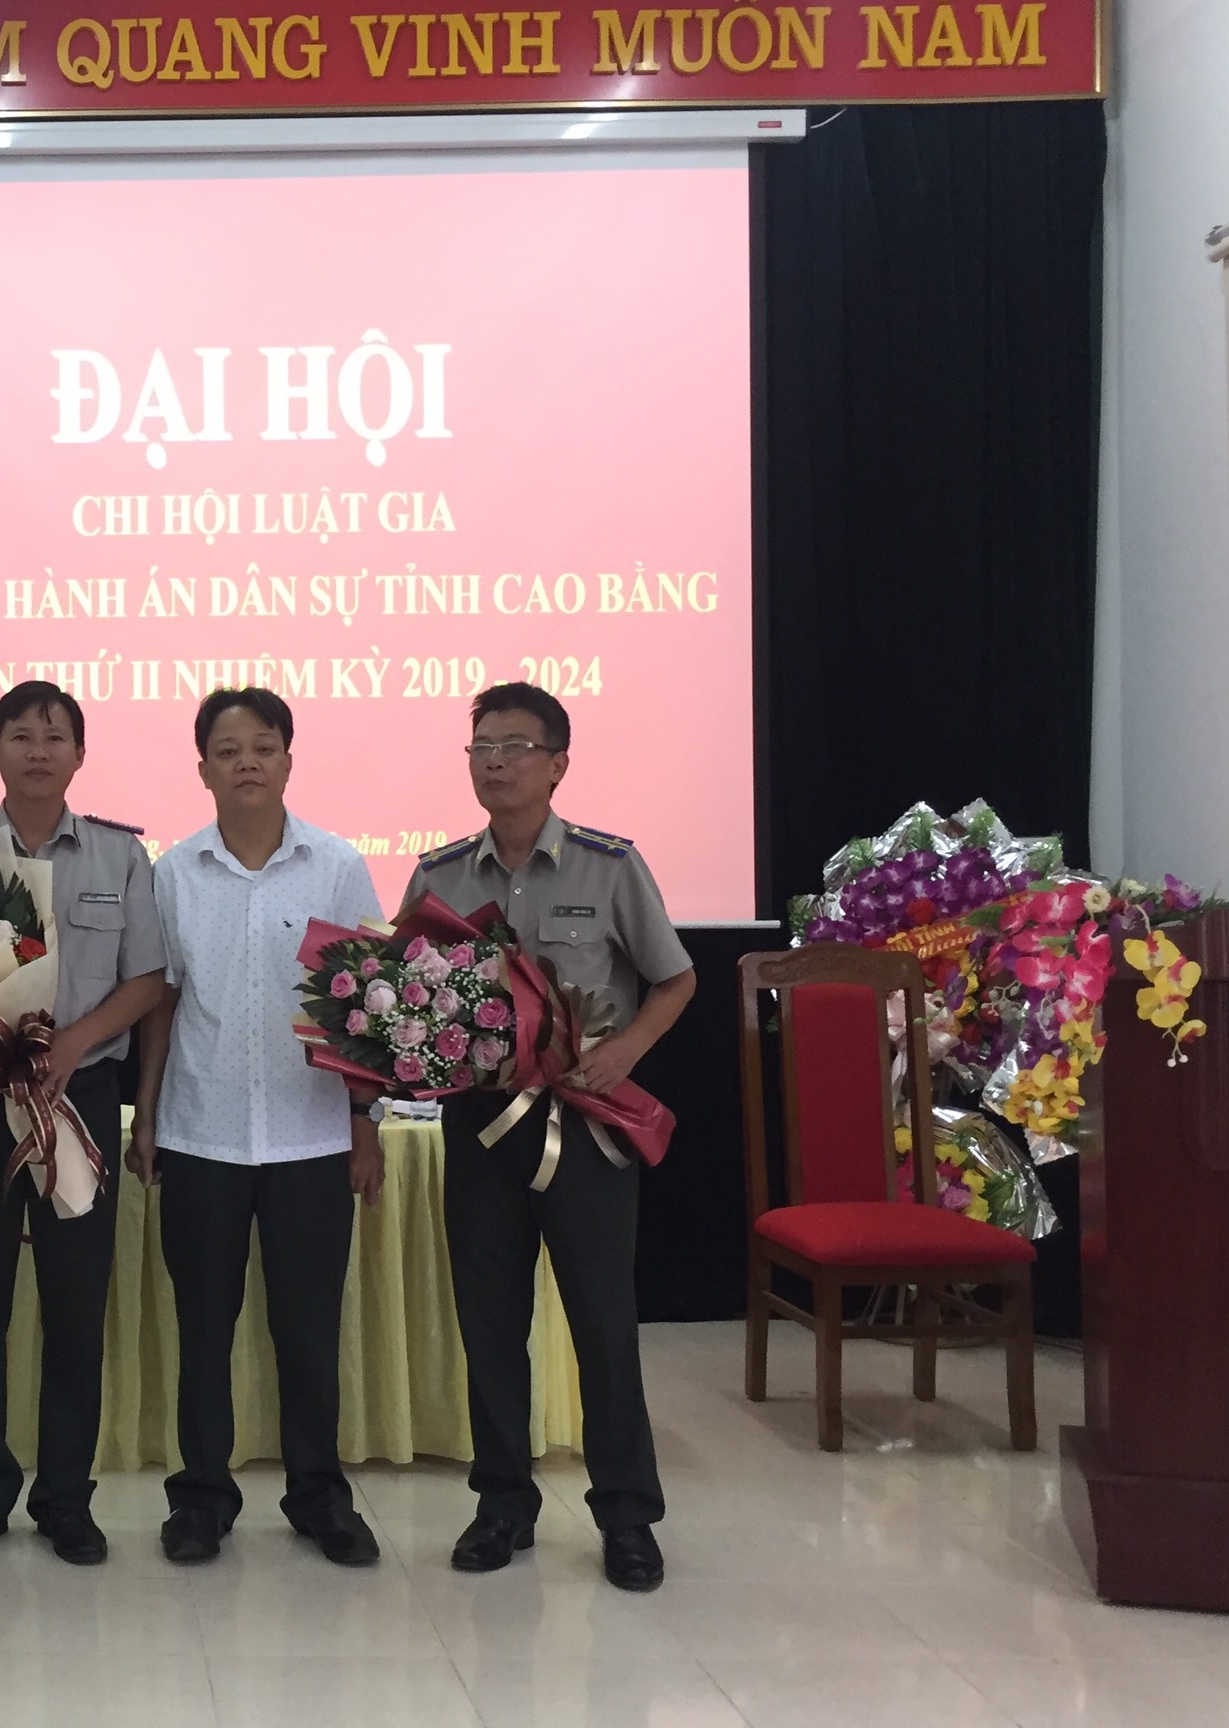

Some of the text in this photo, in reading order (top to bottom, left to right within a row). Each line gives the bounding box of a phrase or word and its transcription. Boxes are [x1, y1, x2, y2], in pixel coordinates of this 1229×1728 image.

[57, 15, 327, 89] QUANG
[351, 11, 561, 77] VINH
[48, 327, 454, 471] ĐẠI HỘI
[72, 486, 457, 546] CHI HỘI LUẬT GIA
[4, 567, 127, 619] HÀNH
[138, 565, 197, 618] ÁN
[209, 561, 297, 617] DÂN
[309, 567, 369, 627] SỰ
[375, 562, 481, 615] TỈNH
[493, 573, 586, 615] CAO
[598, 561, 718, 613] BẰNG
[26, 648, 122, 702] THỨ
[131, 660, 161, 700] II
[330, 645, 391, 698] KỲ
[402, 656, 486, 698] 2019
[519, 656, 603, 697] 2024
